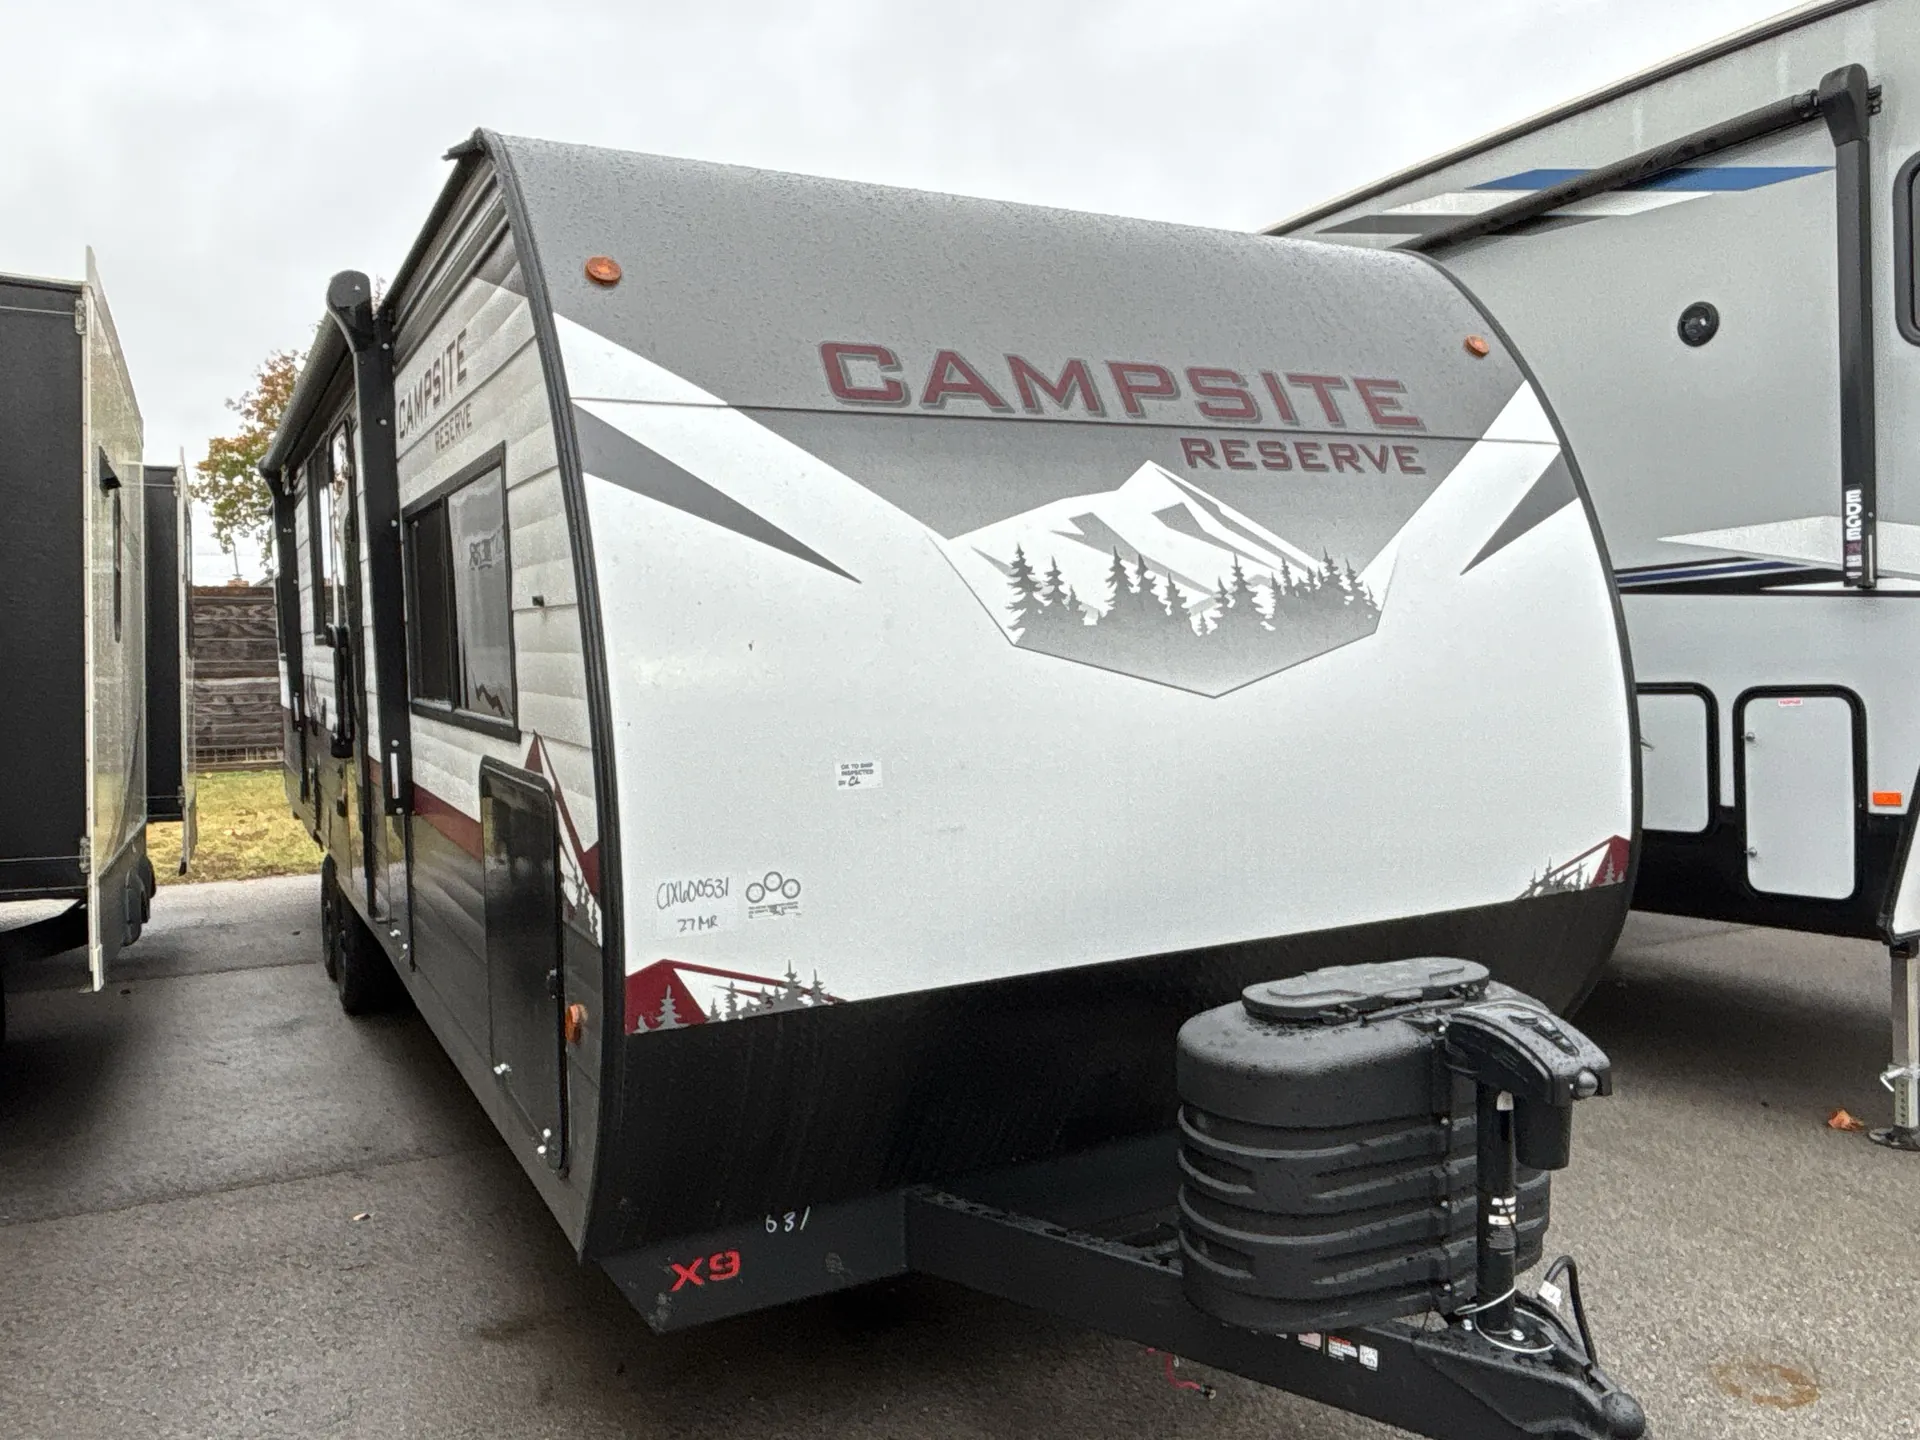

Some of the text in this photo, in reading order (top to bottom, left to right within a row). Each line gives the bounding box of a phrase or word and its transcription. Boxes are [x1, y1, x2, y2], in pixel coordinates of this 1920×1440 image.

[400, 328, 467, 439] CAMPSITE
[820, 342, 1425, 429] CAMPSITE
[434, 403, 472, 453] RESERVE
[1180, 437, 1425, 473] RESERVE
[1845, 489, 1862, 541] EDGE
[670, 1250, 740, 1292] X9
